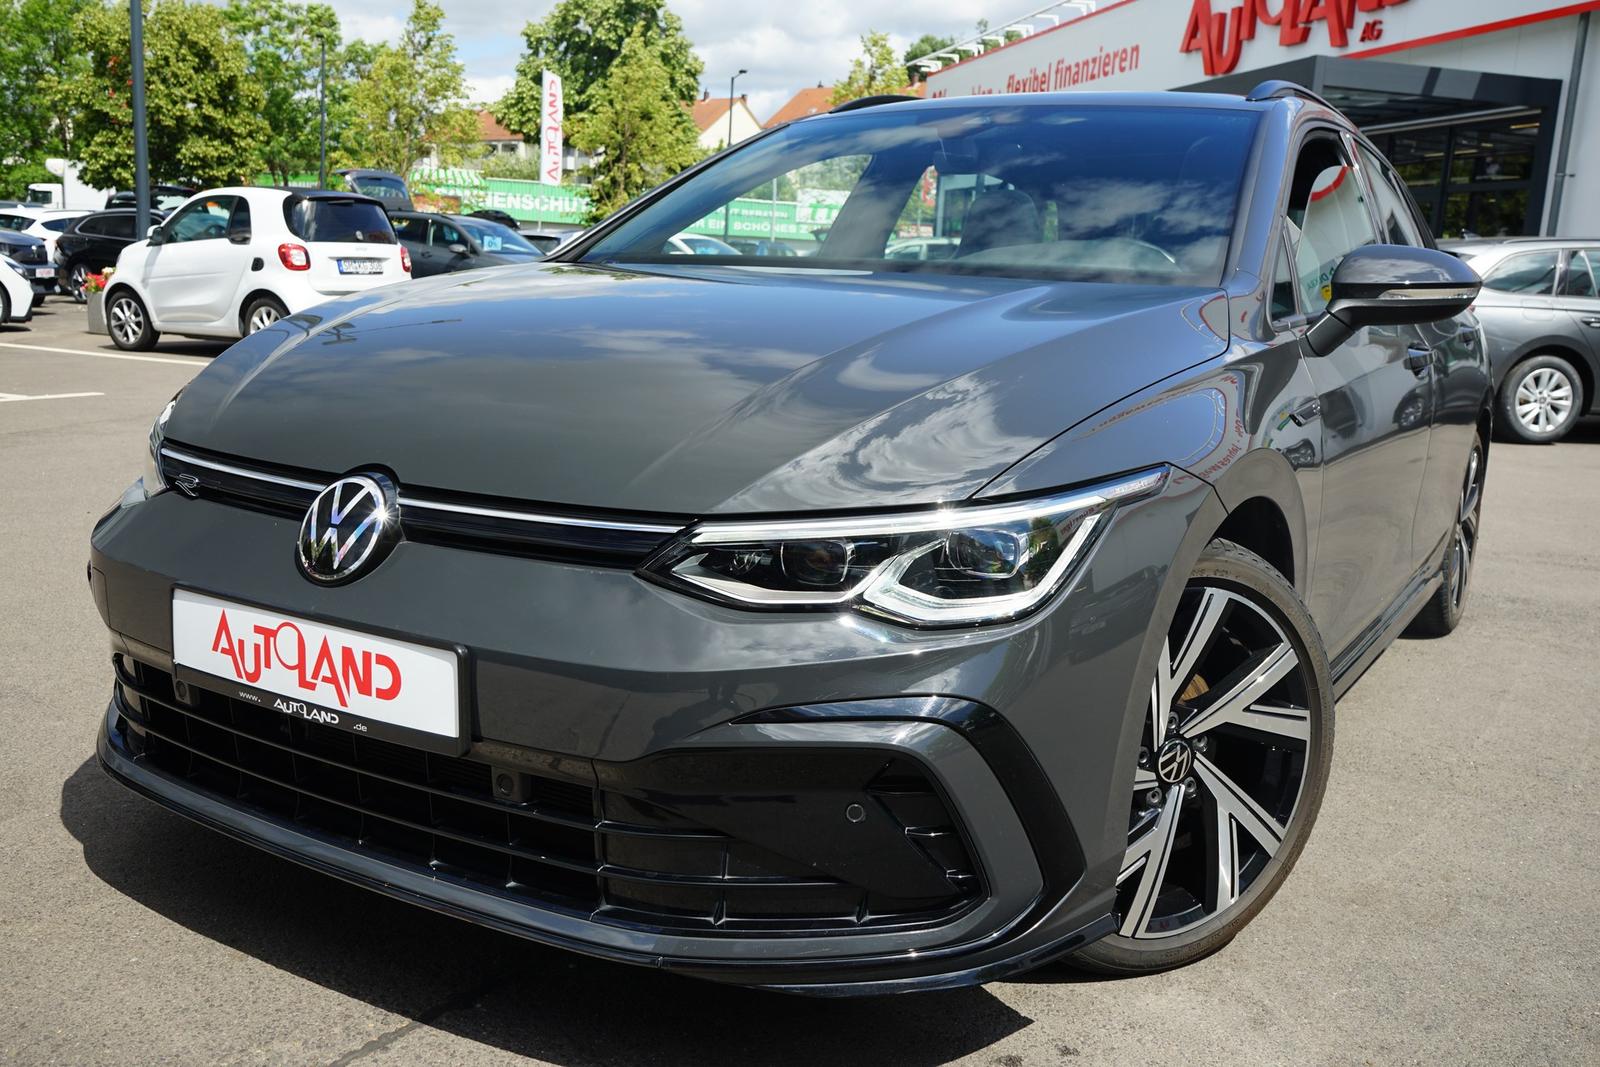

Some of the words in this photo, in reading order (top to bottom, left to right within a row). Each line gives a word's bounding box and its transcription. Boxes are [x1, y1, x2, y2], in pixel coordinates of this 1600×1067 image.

[1359, 19, 1384, 43] AG
[1006, 63, 1051, 94] flexibel
[1054, 44, 1141, 91] finanzieren
[211, 609, 402, 708] AUTOLAND
[273, 698, 339, 725] AUTOLAND
